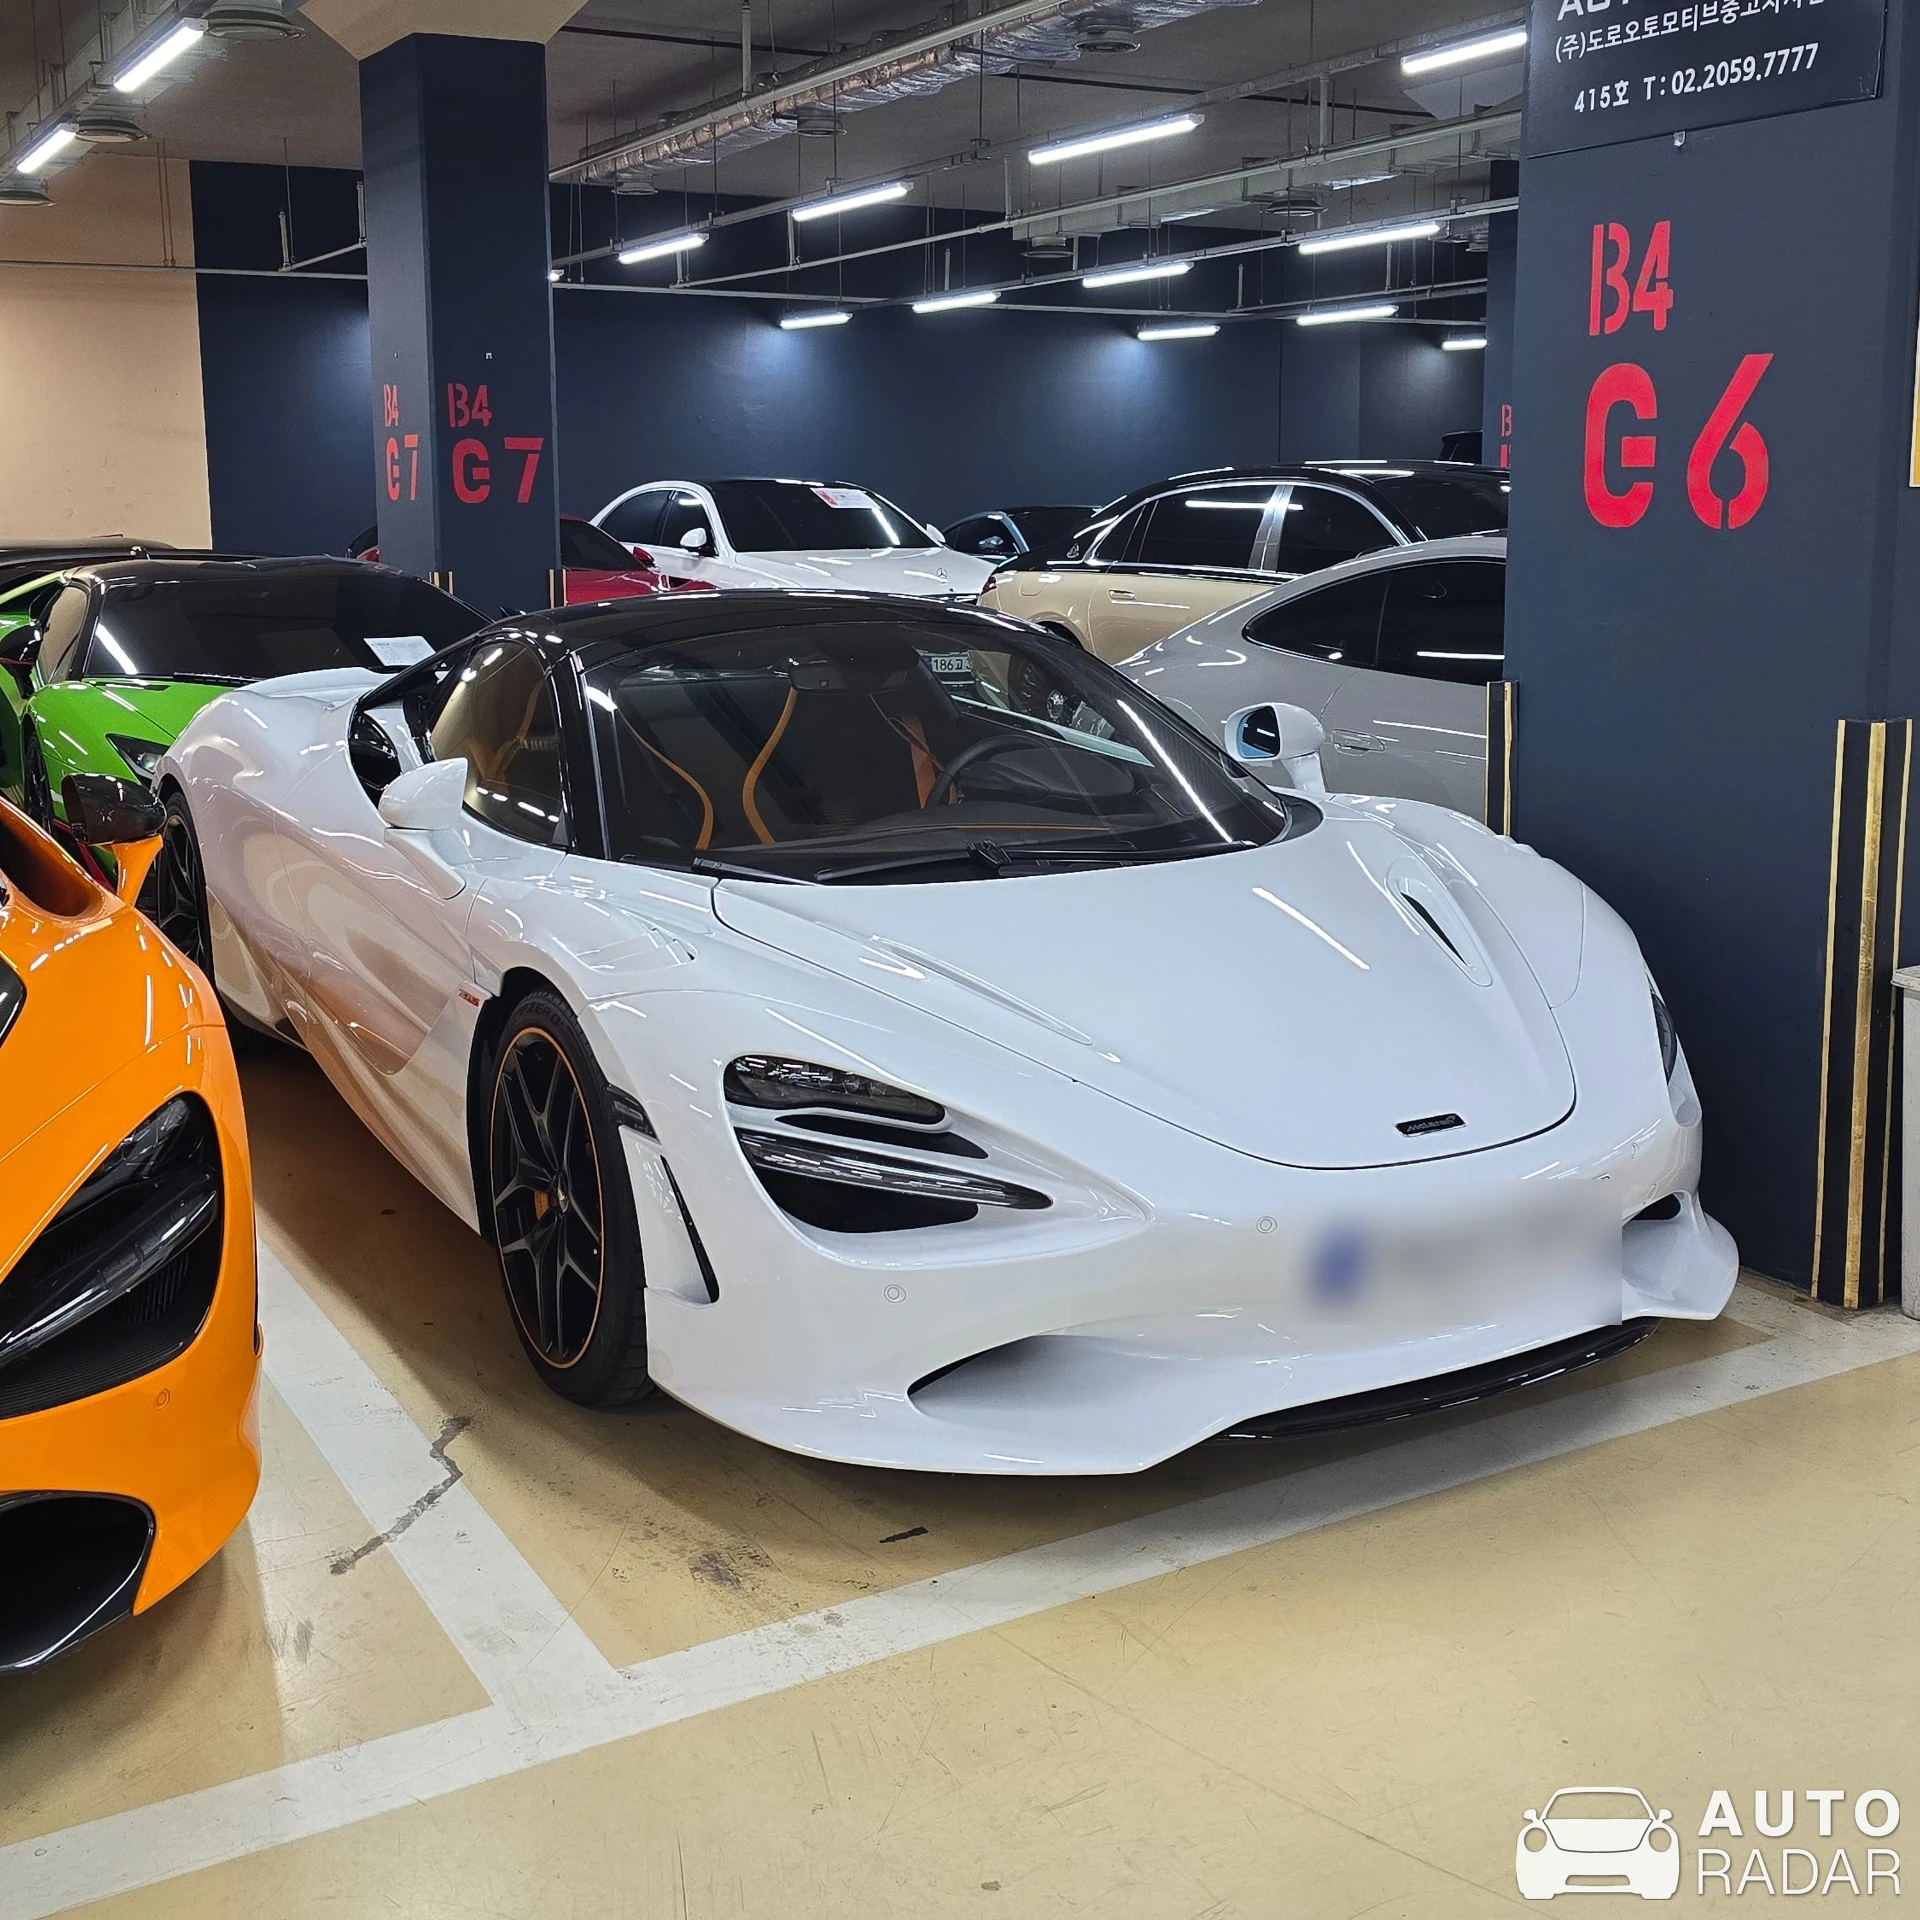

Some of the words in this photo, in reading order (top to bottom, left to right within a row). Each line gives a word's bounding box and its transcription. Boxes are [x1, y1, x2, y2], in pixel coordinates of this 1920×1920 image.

[1573, 80, 1630, 113] 415호
[1588, 220, 1673, 336] B4
[383, 383, 399, 427] B4
[447, 383, 492, 427] B4
